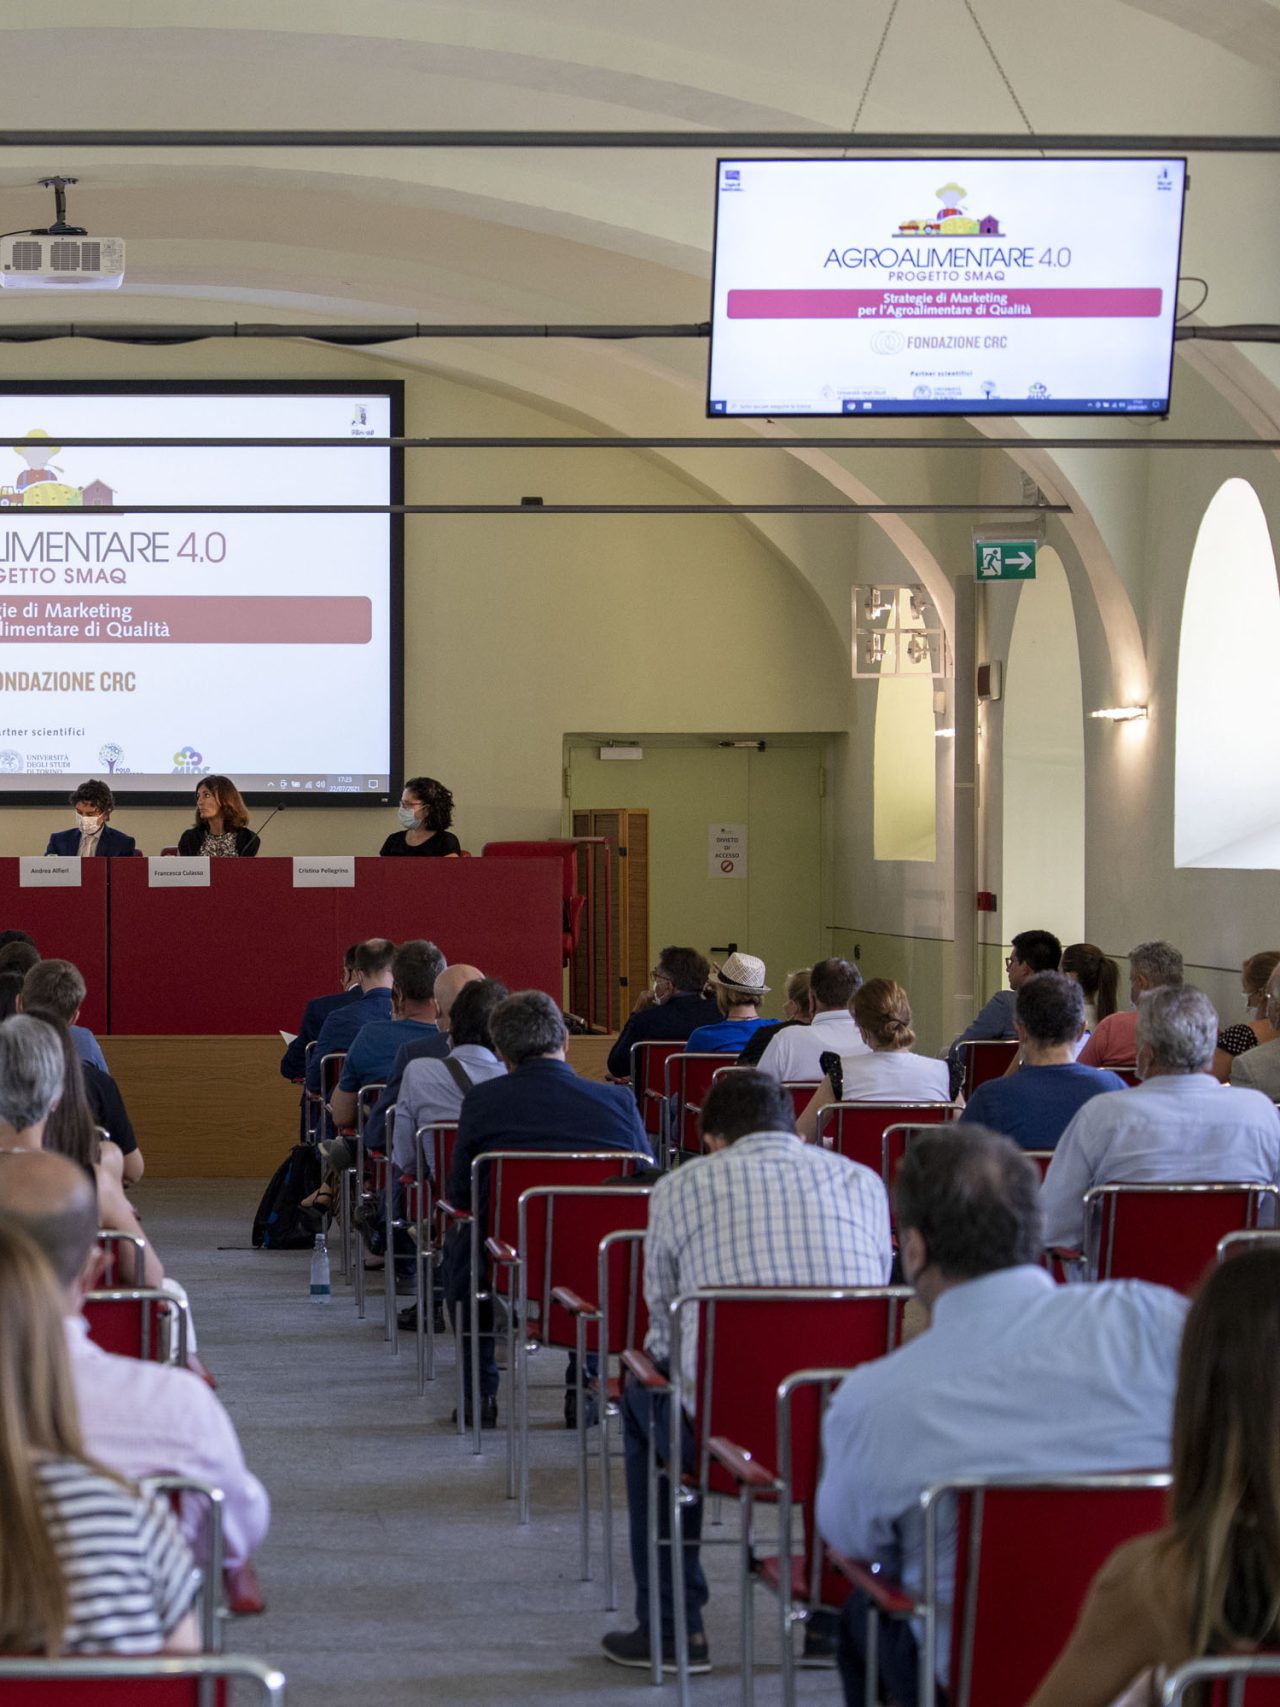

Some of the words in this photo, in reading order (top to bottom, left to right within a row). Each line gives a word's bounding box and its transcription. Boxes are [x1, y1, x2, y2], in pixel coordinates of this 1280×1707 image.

[823, 247, 1035, 269] AGROALIMENTARE
[1038, 247, 1072, 268] 4.0
[888, 270, 960, 282] PROGETTO
[964, 270, 1006, 282] SMAQ
[883, 293, 933, 305] Strategie
[935, 292, 947, 304] di
[950, 292, 1008, 305] Marketing
[857, 306, 877, 317] per
[975, 304, 987, 315] di
[989, 303, 1032, 315] Qualità
[907, 335, 981, 350] FONDAZIONE
[983, 335, 1008, 349] CRC
[176, 531, 228, 564] 4.0
[63, 567, 128, 585] SMAQ
[22, 601, 38, 618] di
[44, 601, 133, 621] Marketing
[84, 620, 100, 637] di
[106, 619, 171, 640] Qualità
[99, 671, 137, 693] CRC
[31, 727, 86, 737] scientifici
